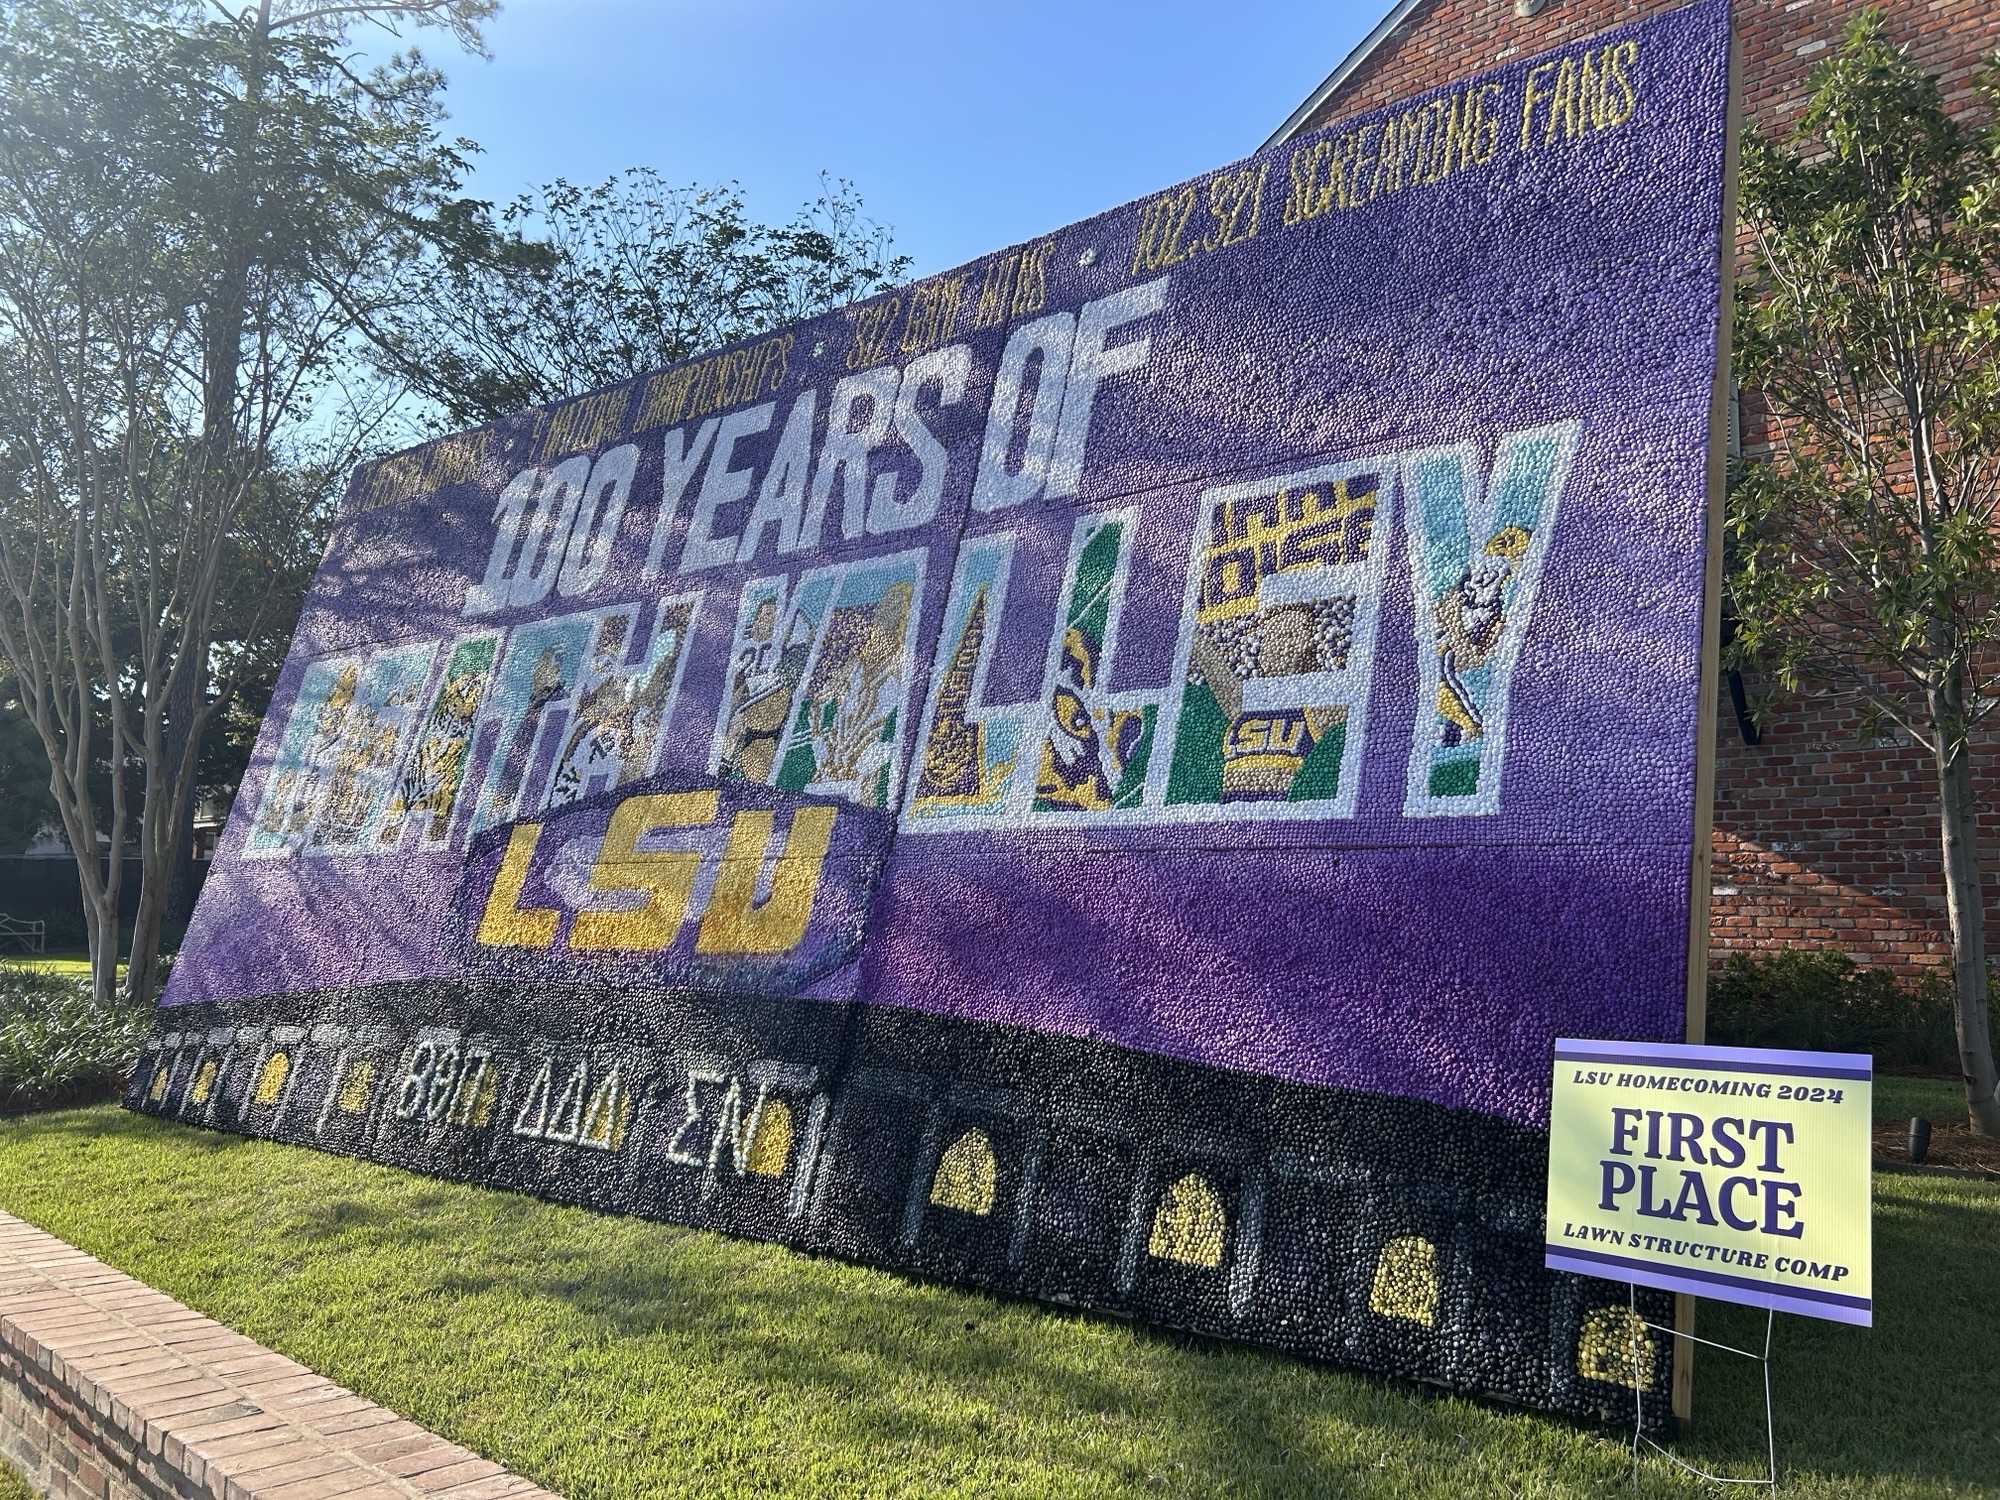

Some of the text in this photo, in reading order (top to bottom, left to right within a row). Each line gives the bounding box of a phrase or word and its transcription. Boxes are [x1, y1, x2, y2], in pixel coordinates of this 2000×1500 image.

[633, 332, 796, 434] CHAMPIONSHIPS
[975, 240, 1056, 331] WINS
[1283, 82, 1502, 226] SCREAMING
[1519, 39, 1639, 151] FANS
[461, 276, 1171, 617] 100 YEARS OF
[240, 418, 1584, 863] DEATH VALLEY
[474, 789, 839, 956] LSU
[1572, 1070, 1844, 1104] LSU HOMECOMING 2024
[1608, 1106, 1795, 1174] FIRST
[1562, 1222, 1850, 1283] LAWN STRUCTURE COMP
[1597, 1159, 1805, 1240] PLACE
